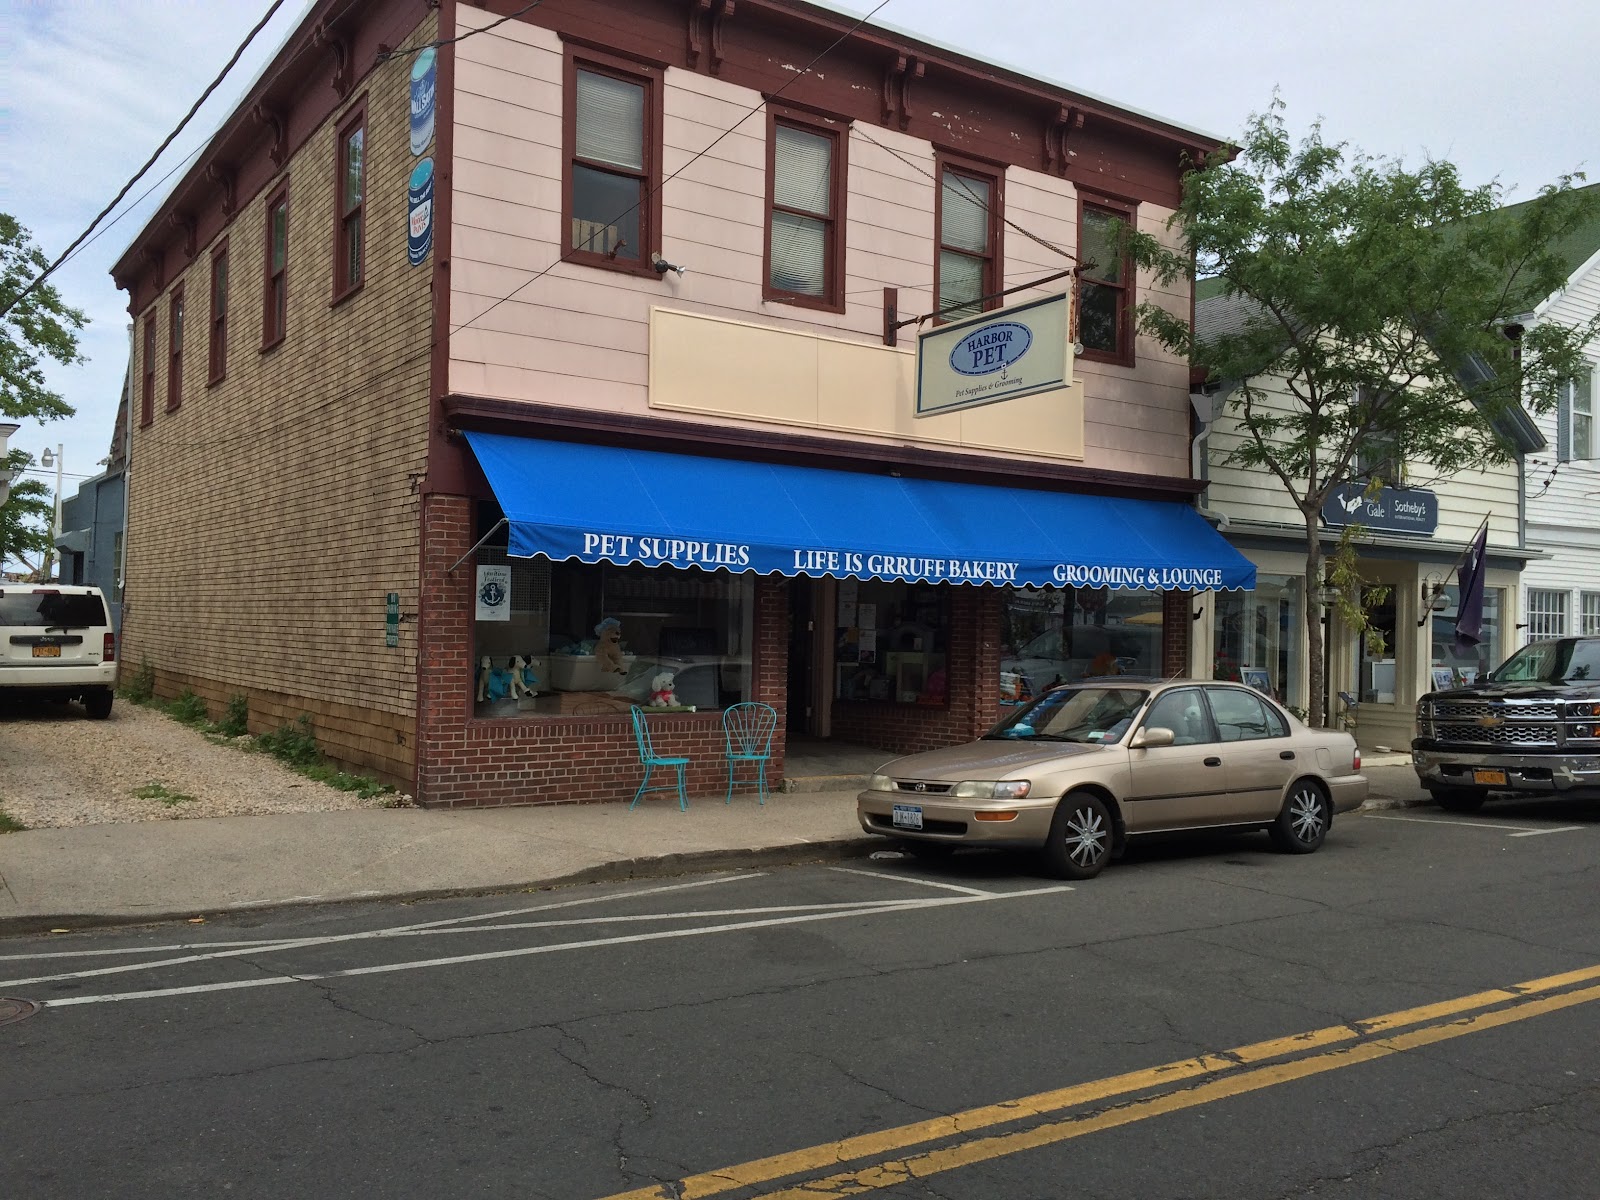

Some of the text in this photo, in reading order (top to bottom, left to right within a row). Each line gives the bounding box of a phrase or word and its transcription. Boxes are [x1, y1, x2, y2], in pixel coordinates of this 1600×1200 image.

[967, 330, 1013, 352] HARBOR
[972, 343, 1008, 369] PET
[955, 389, 965, 398] Pet
[965, 384, 988, 397] Supplies
[994, 376, 1023, 389] Grooming
[1366, 503, 1385, 518] Gale
[1394, 499, 1426, 517] Sotheby's
[583, 533, 749, 566] PET SUPPLIES
[793, 550, 1019, 580] LIFE IS GRRUFF BAKERY
[1053, 564, 1222, 585] GROOMING & LOUNGE
